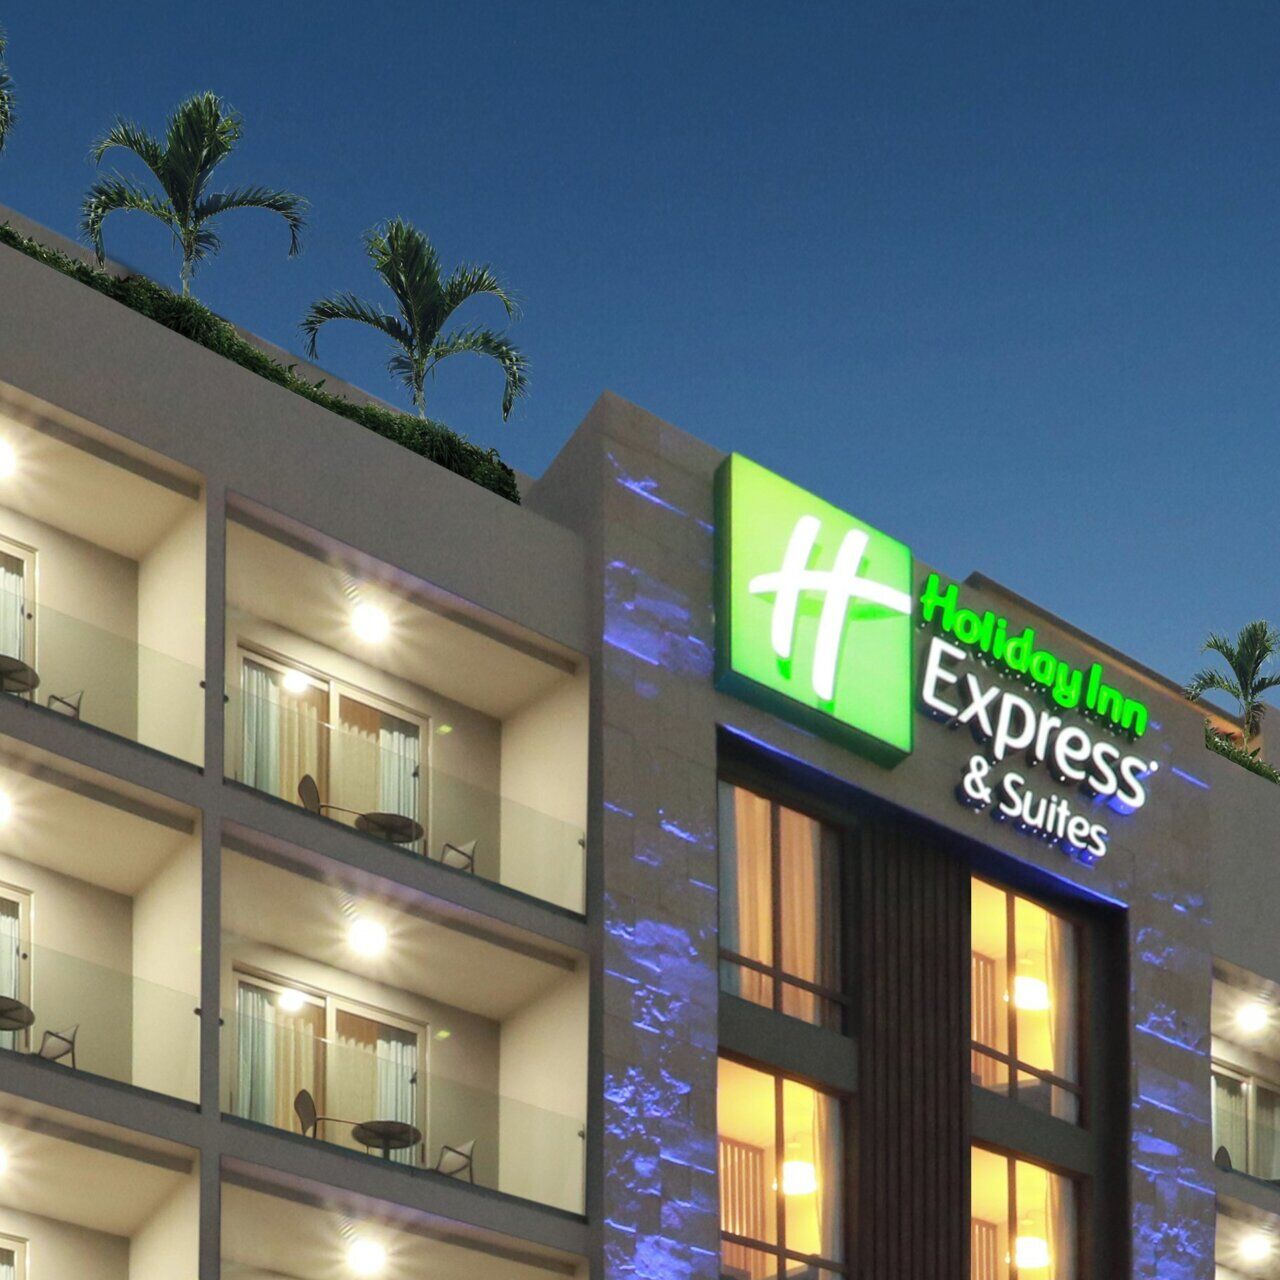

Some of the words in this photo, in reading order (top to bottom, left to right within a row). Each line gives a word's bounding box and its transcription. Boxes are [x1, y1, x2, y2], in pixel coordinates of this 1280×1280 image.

[920, 573, 1082, 706] Holiday
[1086, 663, 1148, 736] Inn
[922, 637, 1146, 809] Express
[963, 755, 991, 804] &
[1000, 772, 1107, 857] Suites
